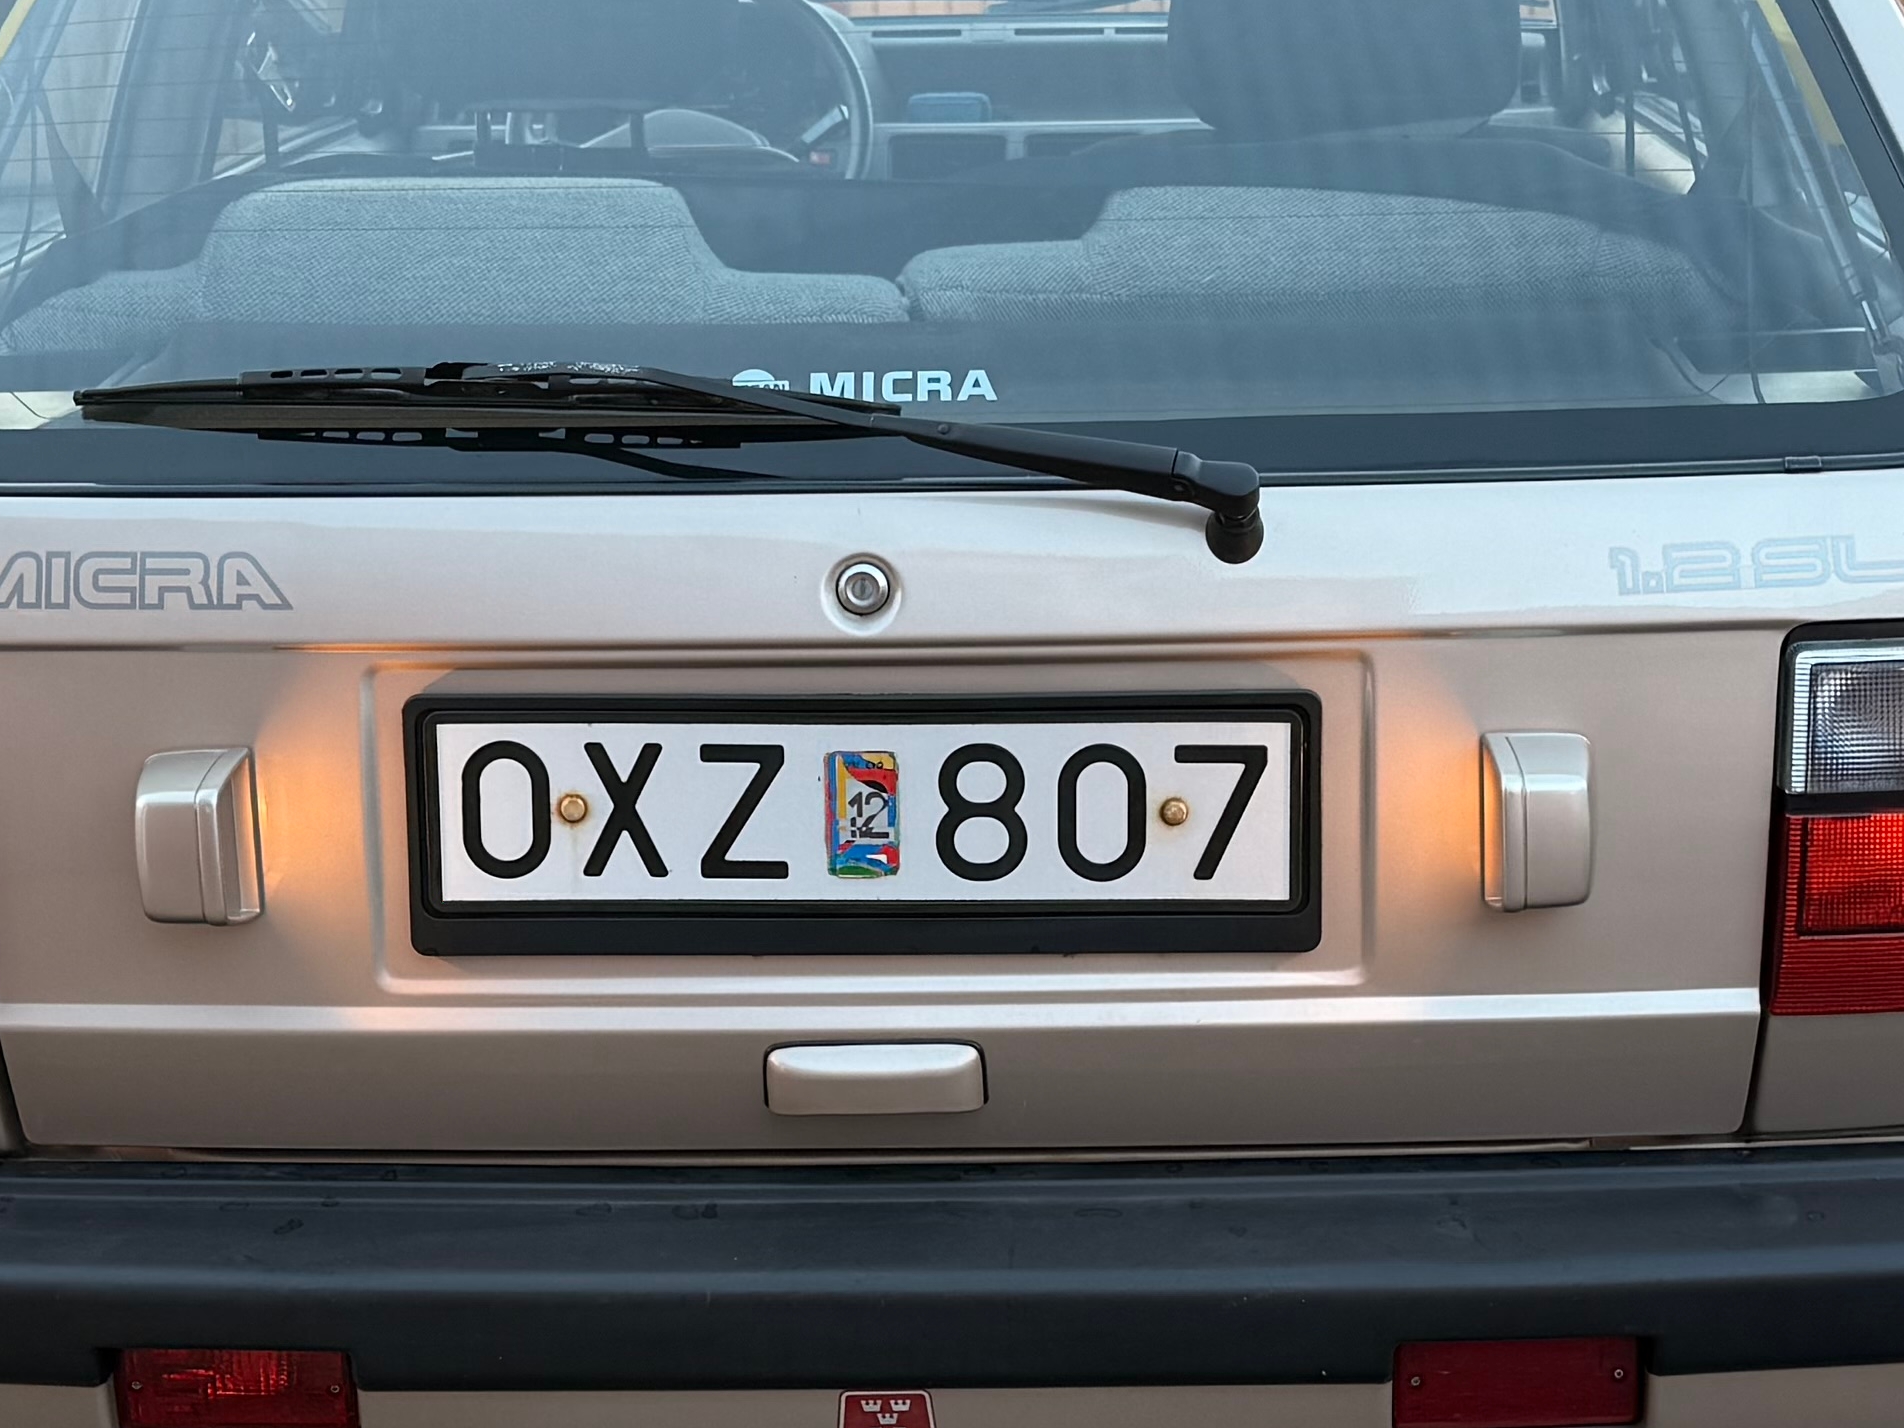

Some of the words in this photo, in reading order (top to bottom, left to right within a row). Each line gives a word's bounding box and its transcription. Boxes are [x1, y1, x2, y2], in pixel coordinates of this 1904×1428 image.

[809, 369, 998, 403] MICRA
[461, 740, 790, 880] OXZ
[935, 743, 1268, 883] 807
